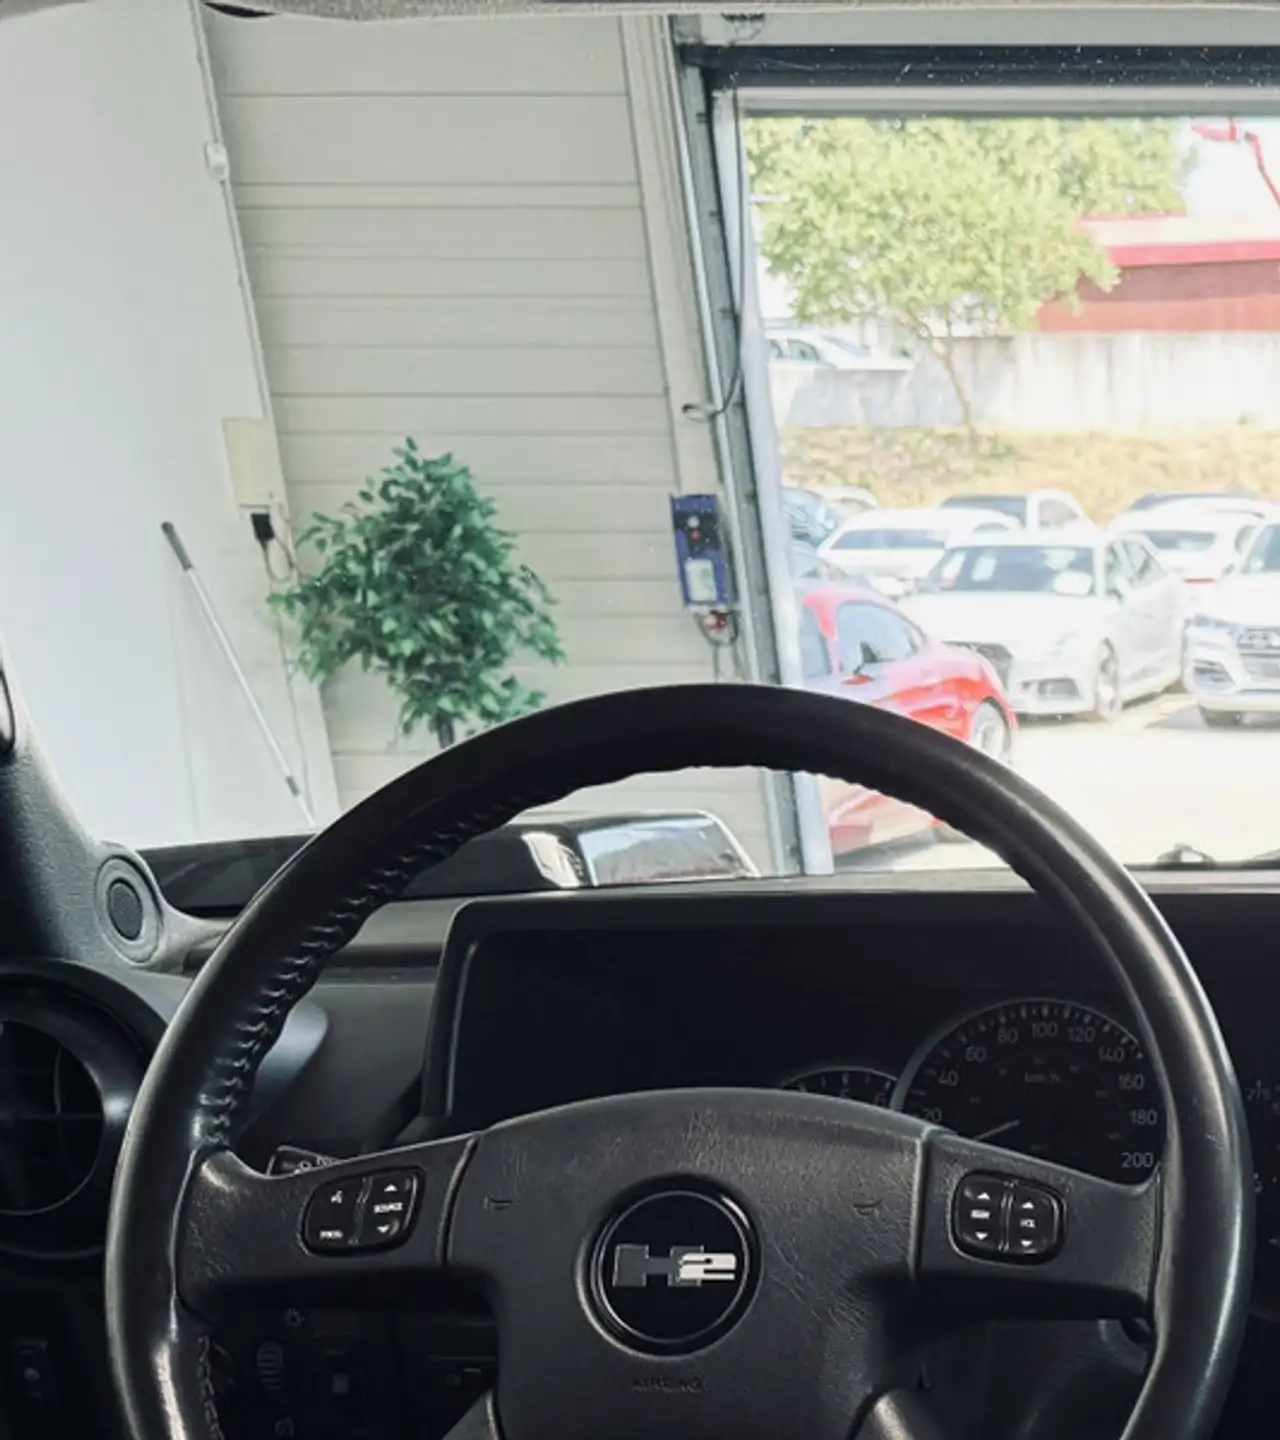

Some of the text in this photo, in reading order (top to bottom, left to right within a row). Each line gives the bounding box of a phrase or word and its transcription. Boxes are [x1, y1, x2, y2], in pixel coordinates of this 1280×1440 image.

[997, 1028, 1019, 1045] 80
[1031, 1022, 1058, 1039] 100
[1067, 1027, 1096, 1044] 120
[965, 1046, 987, 1064] 60
[1099, 1046, 1126, 1064] 140
[937, 1071, 959, 1087] 40
[1118, 1073, 1145, 1091] 160
[1130, 1109, 1158, 1127] 180
[1121, 1152, 1155, 1169] 200
[612, 1244, 738, 1288] H2
